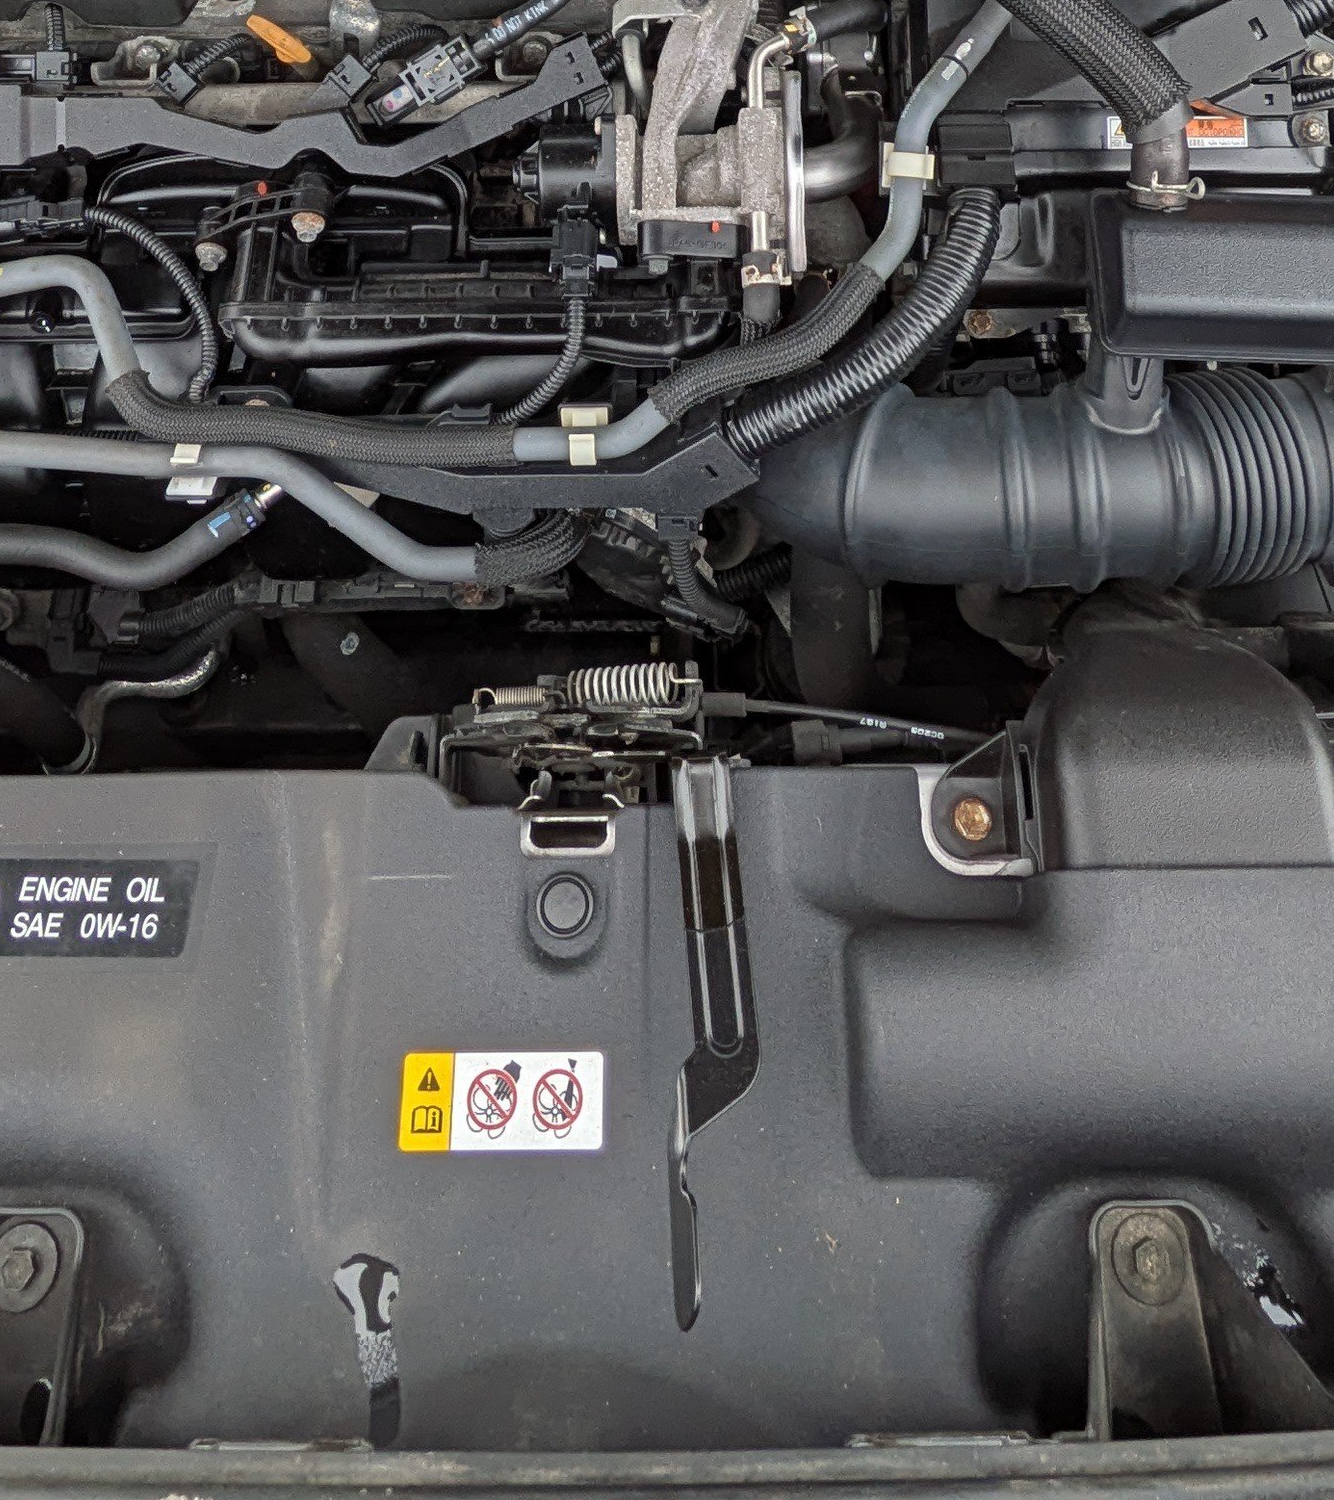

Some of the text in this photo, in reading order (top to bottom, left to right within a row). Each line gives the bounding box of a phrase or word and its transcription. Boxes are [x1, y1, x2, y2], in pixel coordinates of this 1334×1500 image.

[524, 0, 549, 21] KINK
[19, 876, 166, 903] ENGINE OIL
[10, 913, 159, 940] SAE 0W-16
